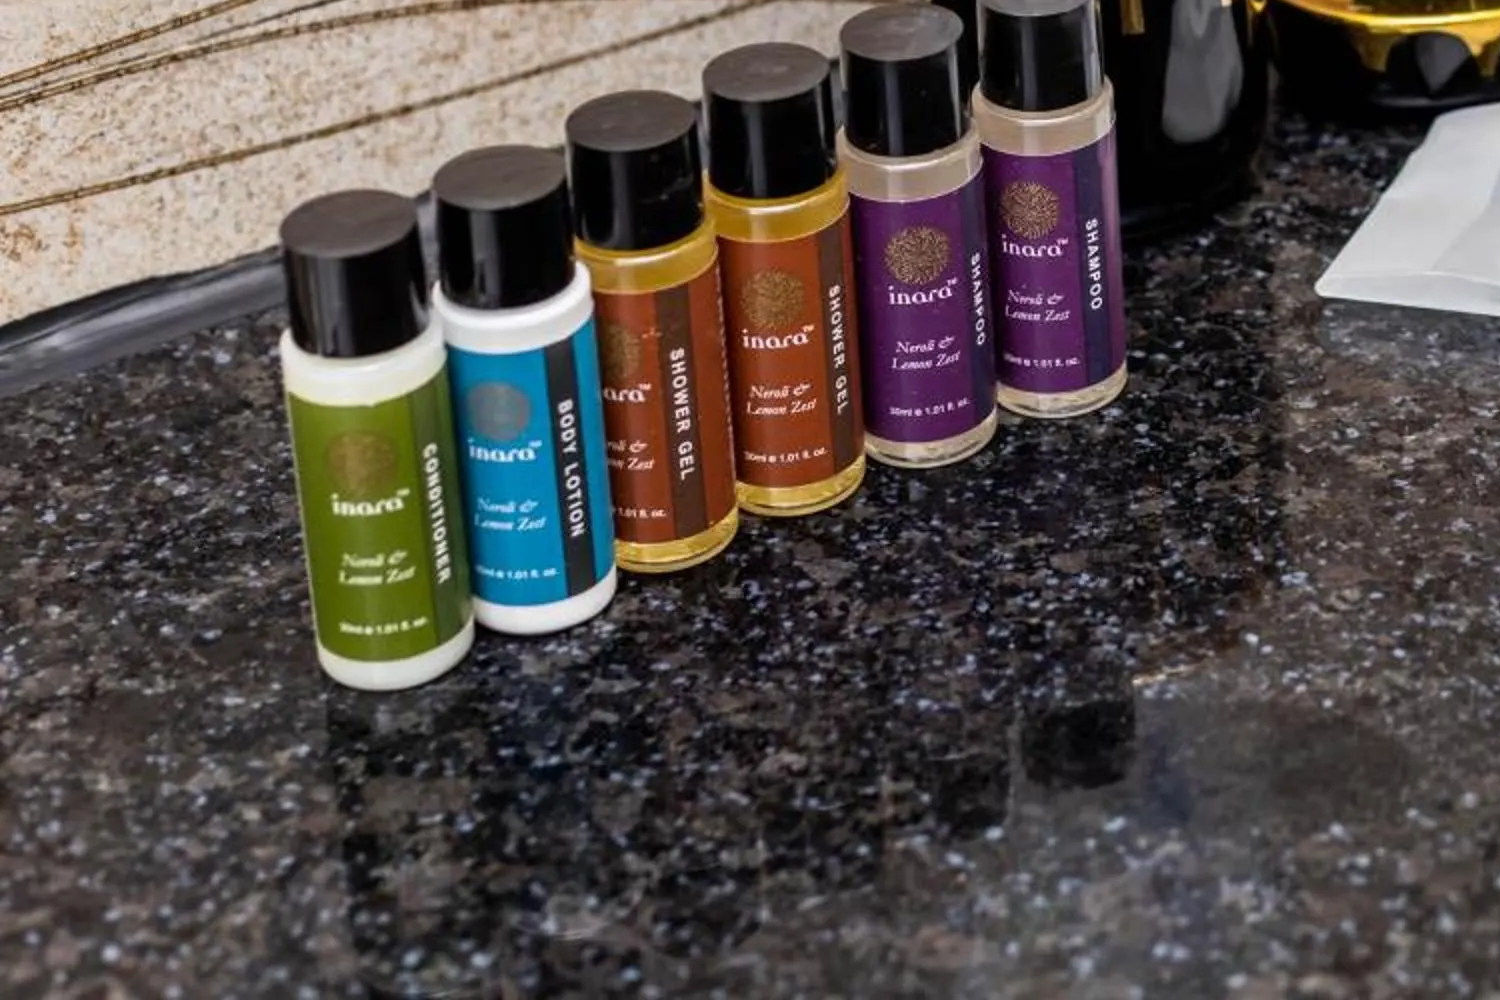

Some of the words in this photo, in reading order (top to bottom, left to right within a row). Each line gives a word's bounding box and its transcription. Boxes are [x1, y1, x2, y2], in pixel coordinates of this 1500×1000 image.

[1084, 218, 1103, 311] SHAMPOO
[971, 252, 986, 345] SHAMPOO
[1047, 292, 1065, 306] &
[828, 284, 846, 369] SHOWER
[1044, 309, 1071, 322] Zest
[895, 340, 935, 354] Neroli
[937, 336, 955, 350] &
[935, 351, 961, 368] Zest
[669, 348, 692, 434] SHOWER
[750, 384, 788, 399] Neroli
[792, 383, 812, 397] &
[834, 375, 850, 416] GEL
[747, 401, 787, 416] Lemon
[791, 398, 817, 415] Zest
[557, 398, 578, 455] BODY
[629, 440, 648, 453] &
[677, 441, 695, 481] GEL
[779, 452, 800, 464] 1.01
[627, 456, 655, 471] Zest
[422, 442, 452, 584] CONDITIONER
[563, 462, 586, 538] LOTION
